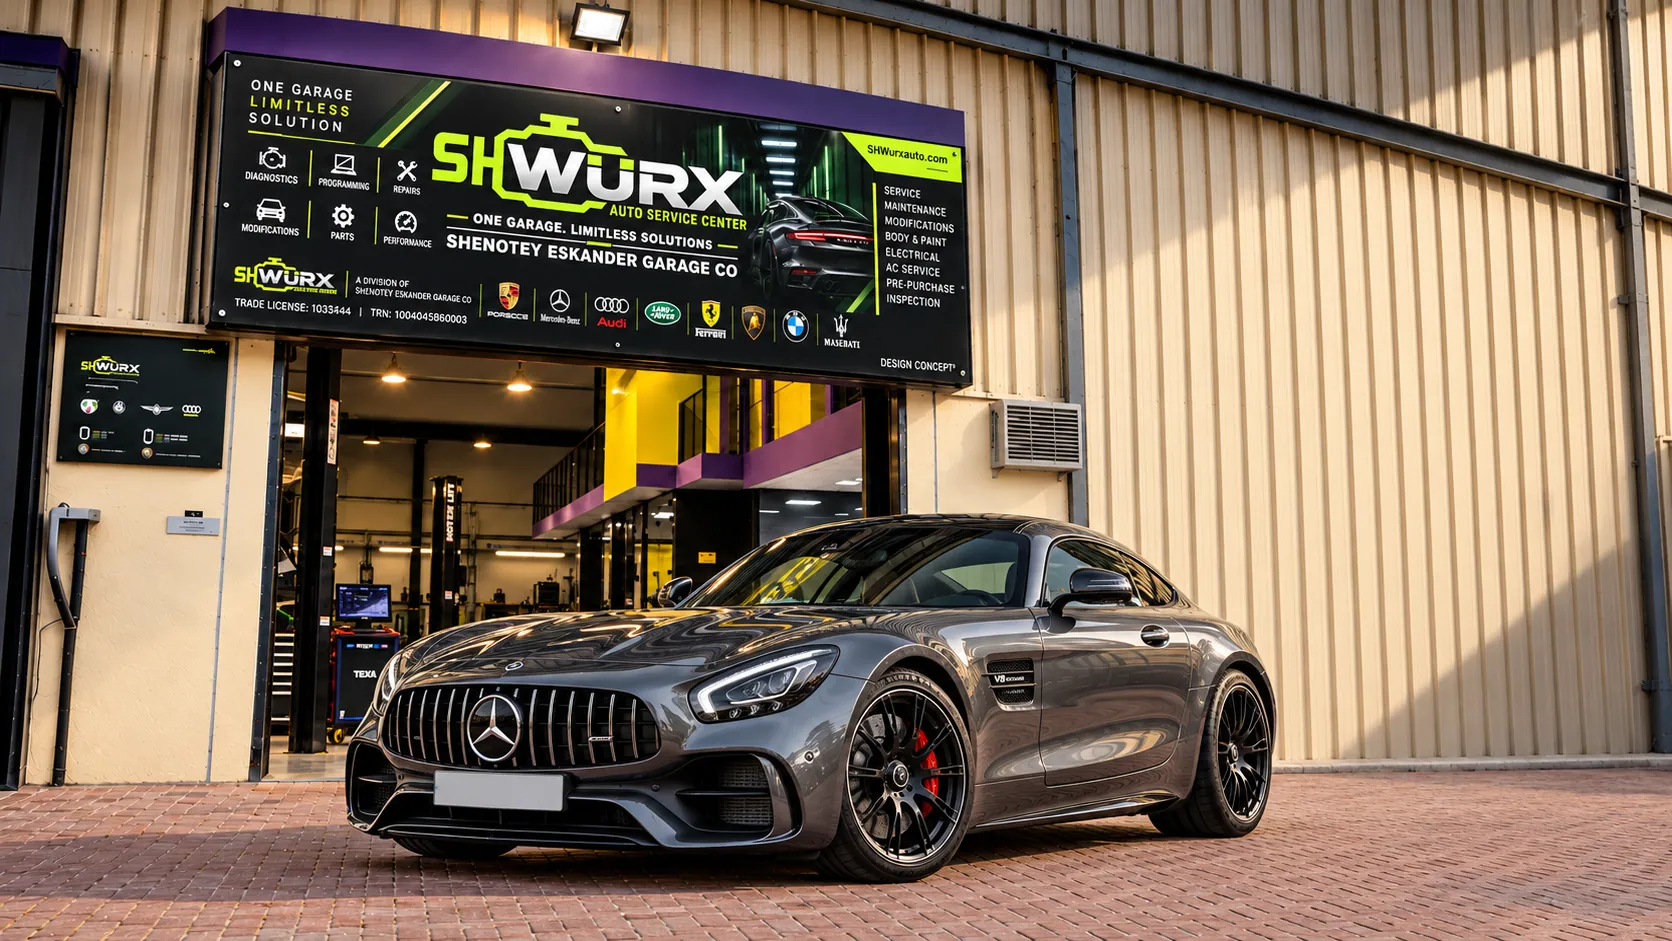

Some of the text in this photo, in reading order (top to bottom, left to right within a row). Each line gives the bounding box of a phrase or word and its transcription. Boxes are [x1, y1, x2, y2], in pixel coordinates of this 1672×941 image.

[251, 79, 353, 101] ONE GARAGE
[250, 96, 350, 117] LIMITLESS
[249, 112, 342, 132] SOLUTION
[867, 144, 948, 164] SHWurxauto.com
[245, 171, 298, 184] DIAGNOSTICS
[318, 178, 370, 191] PROGRAMMING
[393, 185, 420, 195] REPAIRS
[884, 186, 921, 199] SERVICE
[884, 201, 947, 217] MAINTENANCE
[609, 203, 747, 231] AUTO SERVICE CENTER
[241, 223, 300, 236] MODIFICATIONS
[473, 212, 713, 250] ONE GARAGE. LIMITLESS SOLUTIONS
[885, 216, 955, 233] MODIFICATIONS
[330, 231, 355, 241] PARTS
[383, 236, 432, 248] PERFORMANCE
[885, 231, 947, 247] BODY & PAINT
[446, 233, 738, 278] SHENOTEY ESKANDER GARAGE CO
[885, 247, 940, 262] ELECTRICAL
[886, 263, 941, 277] AC SERVICE
[355, 276, 410, 288] A DIVISION OF
[886, 278, 955, 294] PRE-PURCHASE
[355, 286, 472, 304] SHENOTEY ESKANDER GARAGE CO
[886, 294, 941, 308] INSPECTION
[235, 297, 265, 309] TRADE
[267, 300, 309, 313] LICENSE:
[370, 308, 392, 318] TRN:
[395, 310, 467, 324] 1004045860003
[597, 317, 627, 329] Audi
[695, 327, 726, 339] Ferrari
[824, 338, 860, 349] MASERATI
[880, 358, 913, 370] DESIGN
[353, 670, 377, 678] TEXA
[994, 674, 1006, 683] V8
